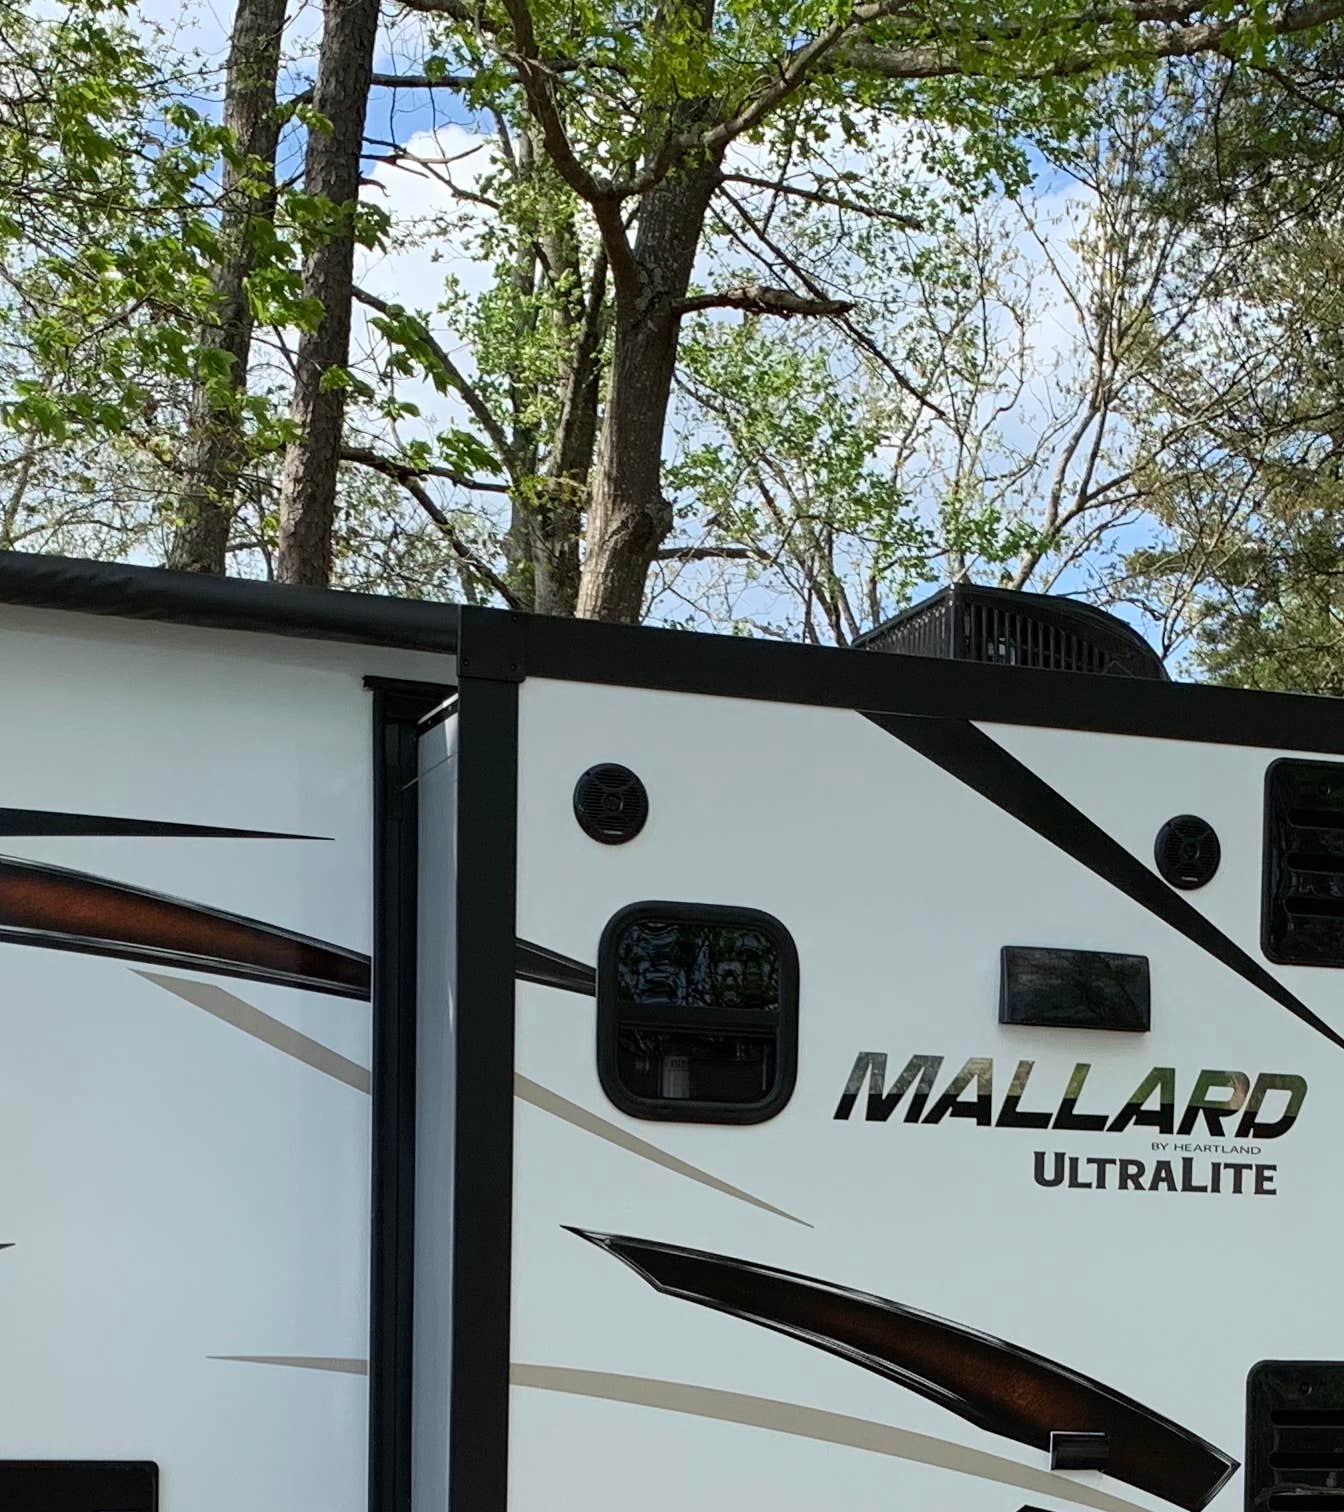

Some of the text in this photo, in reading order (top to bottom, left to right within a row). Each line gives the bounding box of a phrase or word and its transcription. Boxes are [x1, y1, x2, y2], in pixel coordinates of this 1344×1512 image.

[833, 1051, 1308, 1139] MALLARD
[1151, 1142, 1262, 1155] BY HEARTLAND
